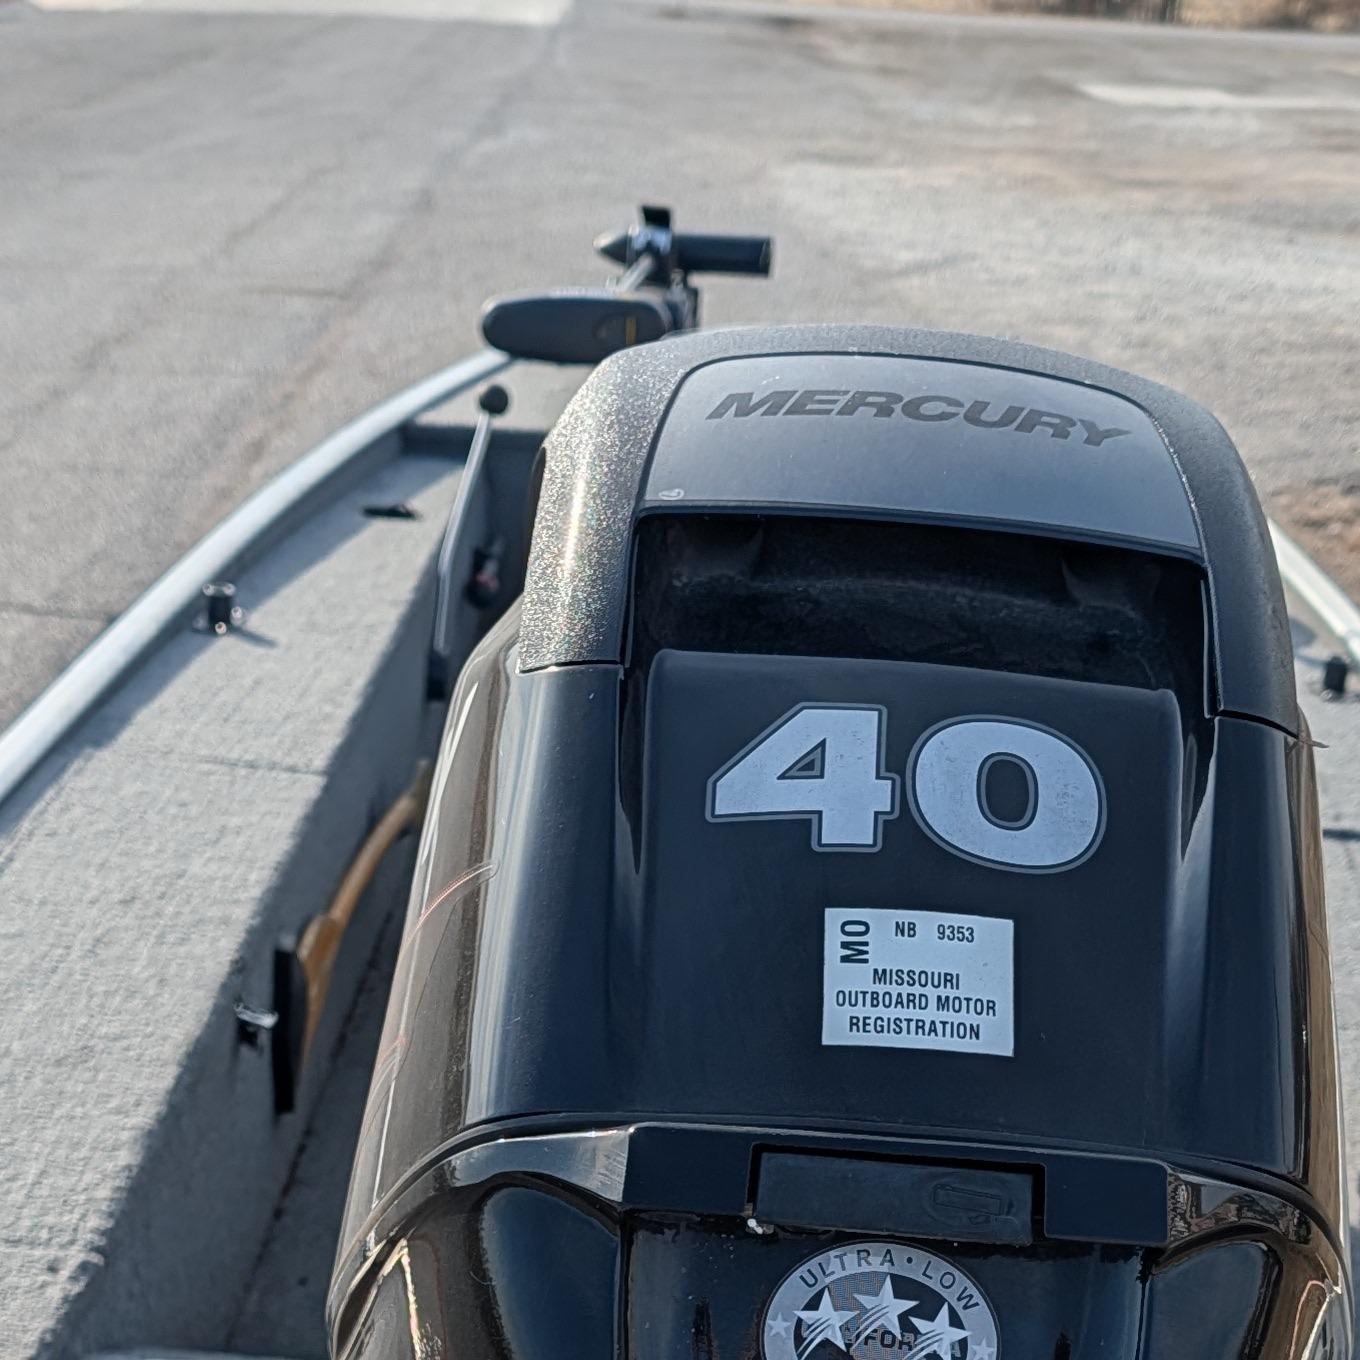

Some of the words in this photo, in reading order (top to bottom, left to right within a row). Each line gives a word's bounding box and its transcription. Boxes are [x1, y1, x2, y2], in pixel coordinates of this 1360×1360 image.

[705, 389, 1132, 448] MERCURY
[706, 702, 1107, 874] 40
[839, 919, 871, 964] MO
[894, 920, 917, 938] NB
[937, 924, 976, 943] 9353
[872, 967, 960, 991] MISSOURI
[835, 990, 929, 1011] OUTBOARD
[935, 995, 997, 1017] MOTOR
[848, 1015, 981, 1041] REGISTRATION
[798, 1248, 896, 1289] ULTRA
[921, 1259, 981, 1312] LOW
